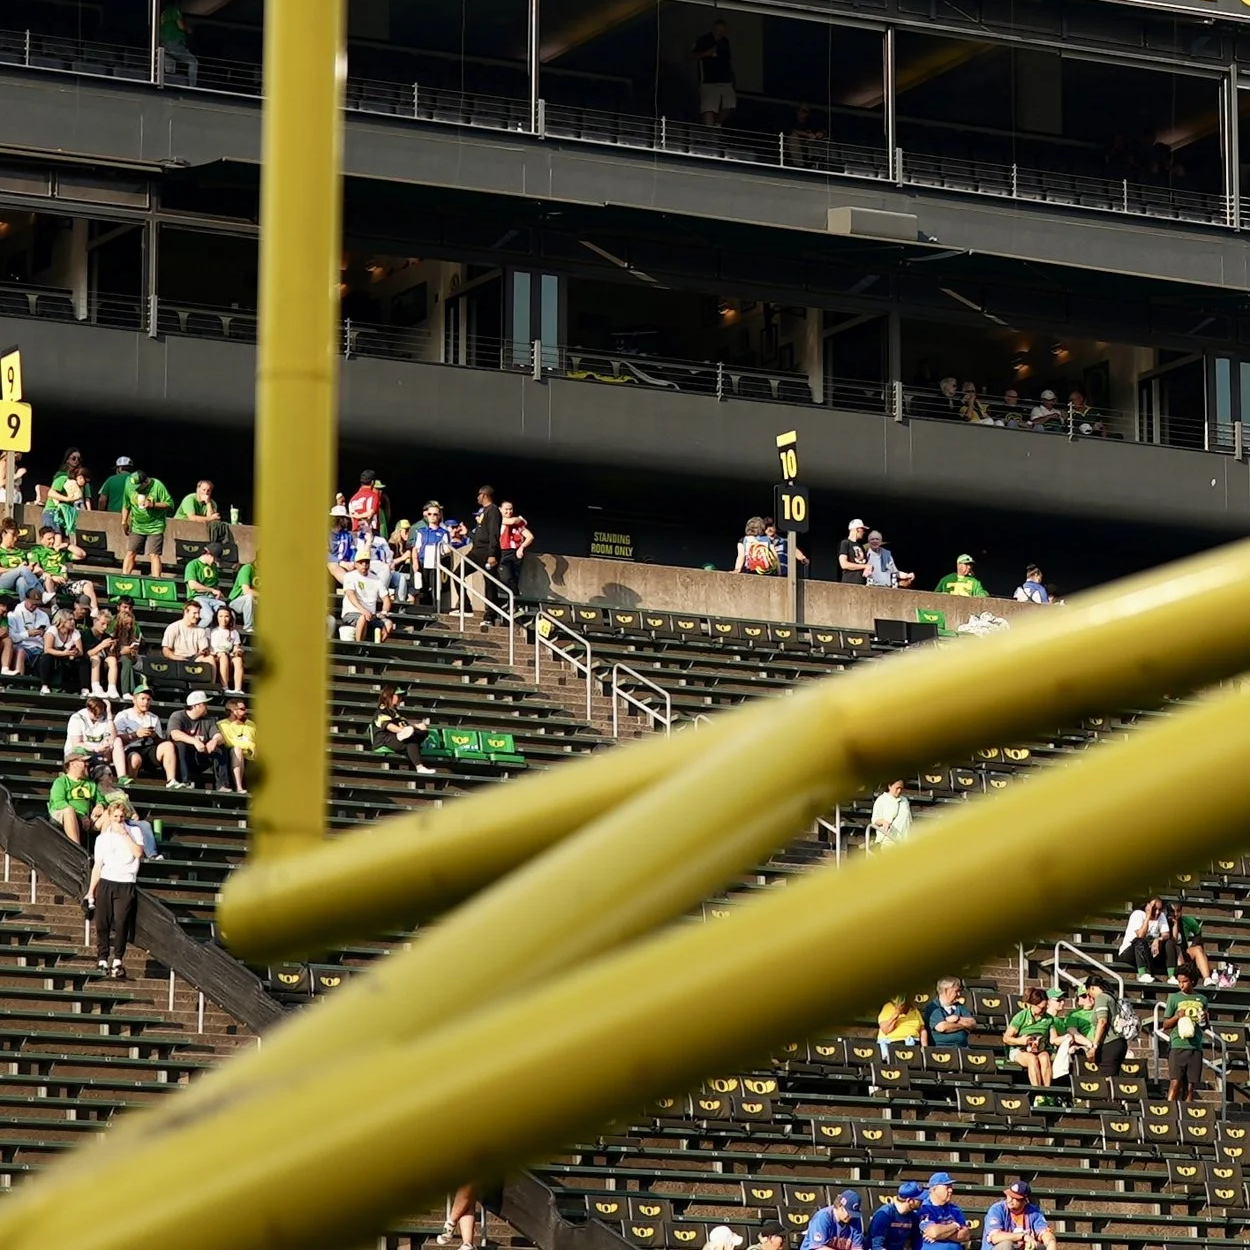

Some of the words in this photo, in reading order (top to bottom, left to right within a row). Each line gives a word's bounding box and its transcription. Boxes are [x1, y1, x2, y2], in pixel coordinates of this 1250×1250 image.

[7, 366, 15, 393] 9
[7, 413, 20, 439] 9
[780, 449, 797, 480] 10
[781, 494, 806, 521] 10
[591, 542, 613, 555] ROOM
[614, 545, 634, 557] ONLY
[593, 531, 631, 545] STANDING
